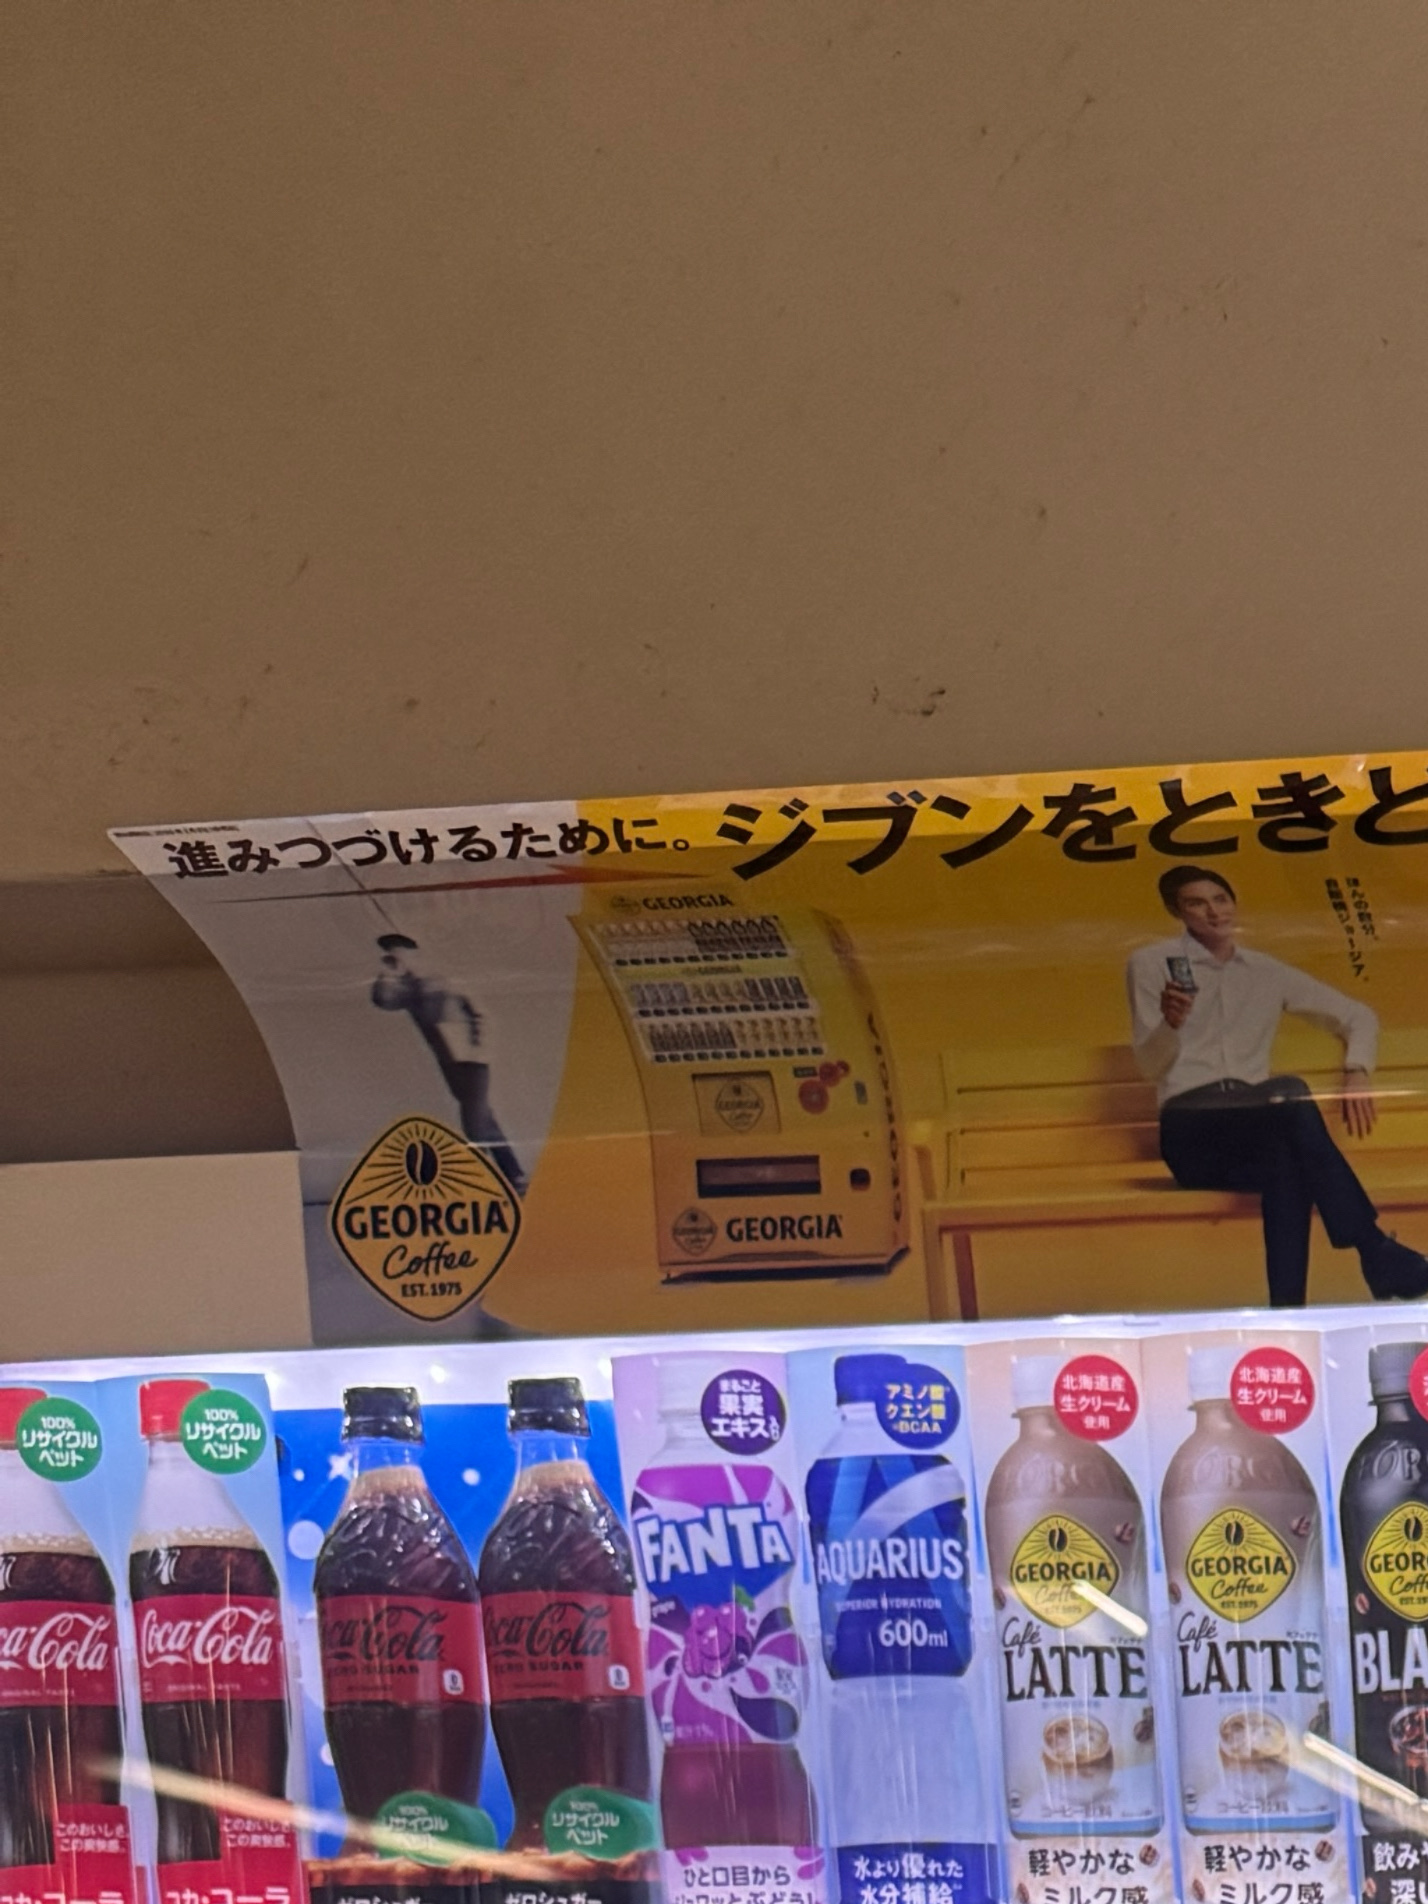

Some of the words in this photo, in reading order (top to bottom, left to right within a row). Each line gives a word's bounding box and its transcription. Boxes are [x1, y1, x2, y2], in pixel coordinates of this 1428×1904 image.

[167, 816, 691, 881] 進みつづけるために。
[345, 1202, 509, 1239] GEORGIA
[725, 1214, 842, 1242] GEORGIA
[383, 1247, 479, 1280] Coffee
[1062, 1374, 1126, 1392] 北海道産
[1239, 1367, 1302, 1384] 北海道産
[719, 1394, 765, 1416] 果実
[1060, 1396, 1131, 1413] 生クリーム
[1237, 1388, 1308, 1406] 生クリーム
[22, 1430, 97, 1449] リサイクル
[185, 1422, 261, 1441] リサイクル
[635, 1505, 791, 1583] FANTA
[817, 1537, 965, 1581] AQUARIUS
[1015, 1560, 1112, 1583] GEORGIA
[1190, 1555, 1288, 1577] GEORGIA
[879, 1618, 949, 1648] 600ml
[1004, 1646, 1148, 1702] LATTE
[1180, 1640, 1324, 1697] LATTE
[854, 1853, 964, 1881] 水より優れた
[1028, 1848, 1135, 1878] 軽やかな
[1203, 1845, 1311, 1872] 軽やかな
[684, 1866, 791, 1889] ひと口目から
